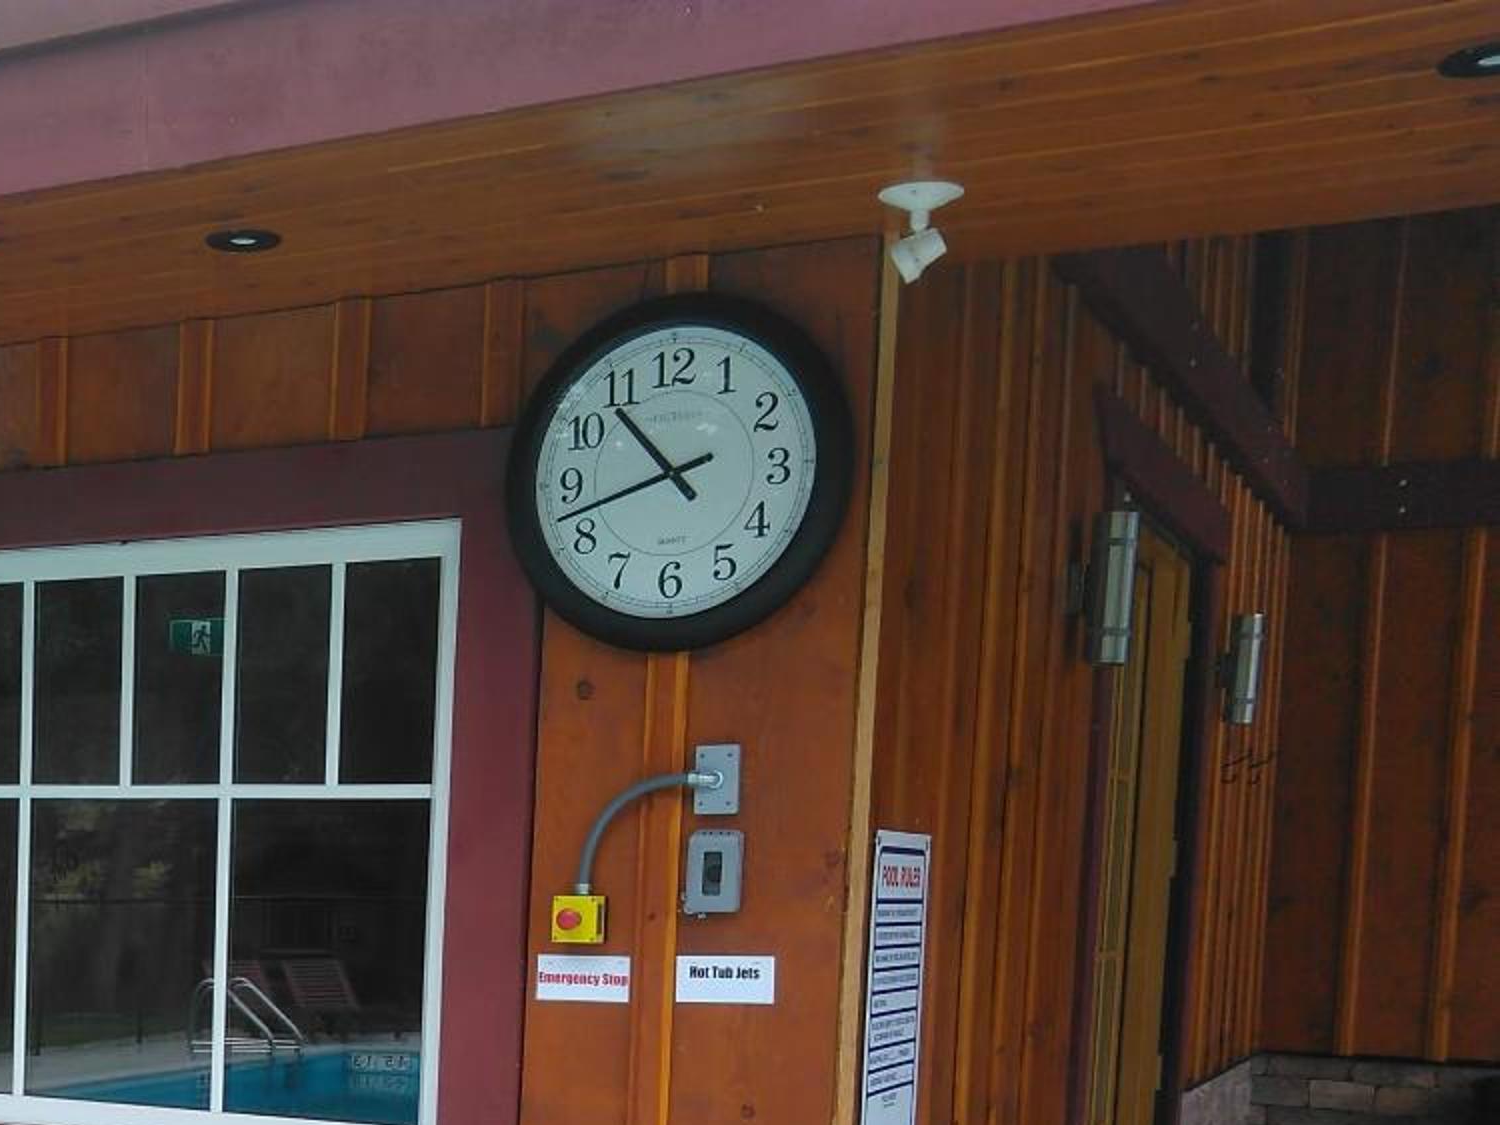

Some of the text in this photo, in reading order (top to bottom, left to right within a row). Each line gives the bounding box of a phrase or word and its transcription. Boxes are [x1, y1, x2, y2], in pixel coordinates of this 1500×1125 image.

[651, 347, 697, 388] 12
[716, 356, 736, 395] 1
[603, 368, 640, 409] 11
[753, 391, 780, 433] 2
[567, 412, 605, 451] 10
[766, 447, 791, 485] 3
[559, 467, 583, 504] 9
[573, 518, 597, 554] 8
[744, 501, 771, 538] 4
[607, 552, 631, 590] 7
[657, 561, 683, 599] 6
[713, 543, 737, 581] 5
[882, 865, 921, 888] POOL RULES
[538, 971, 628, 987] Emergency Stop
[689, 965, 760, 980] Hot Tub Jets
